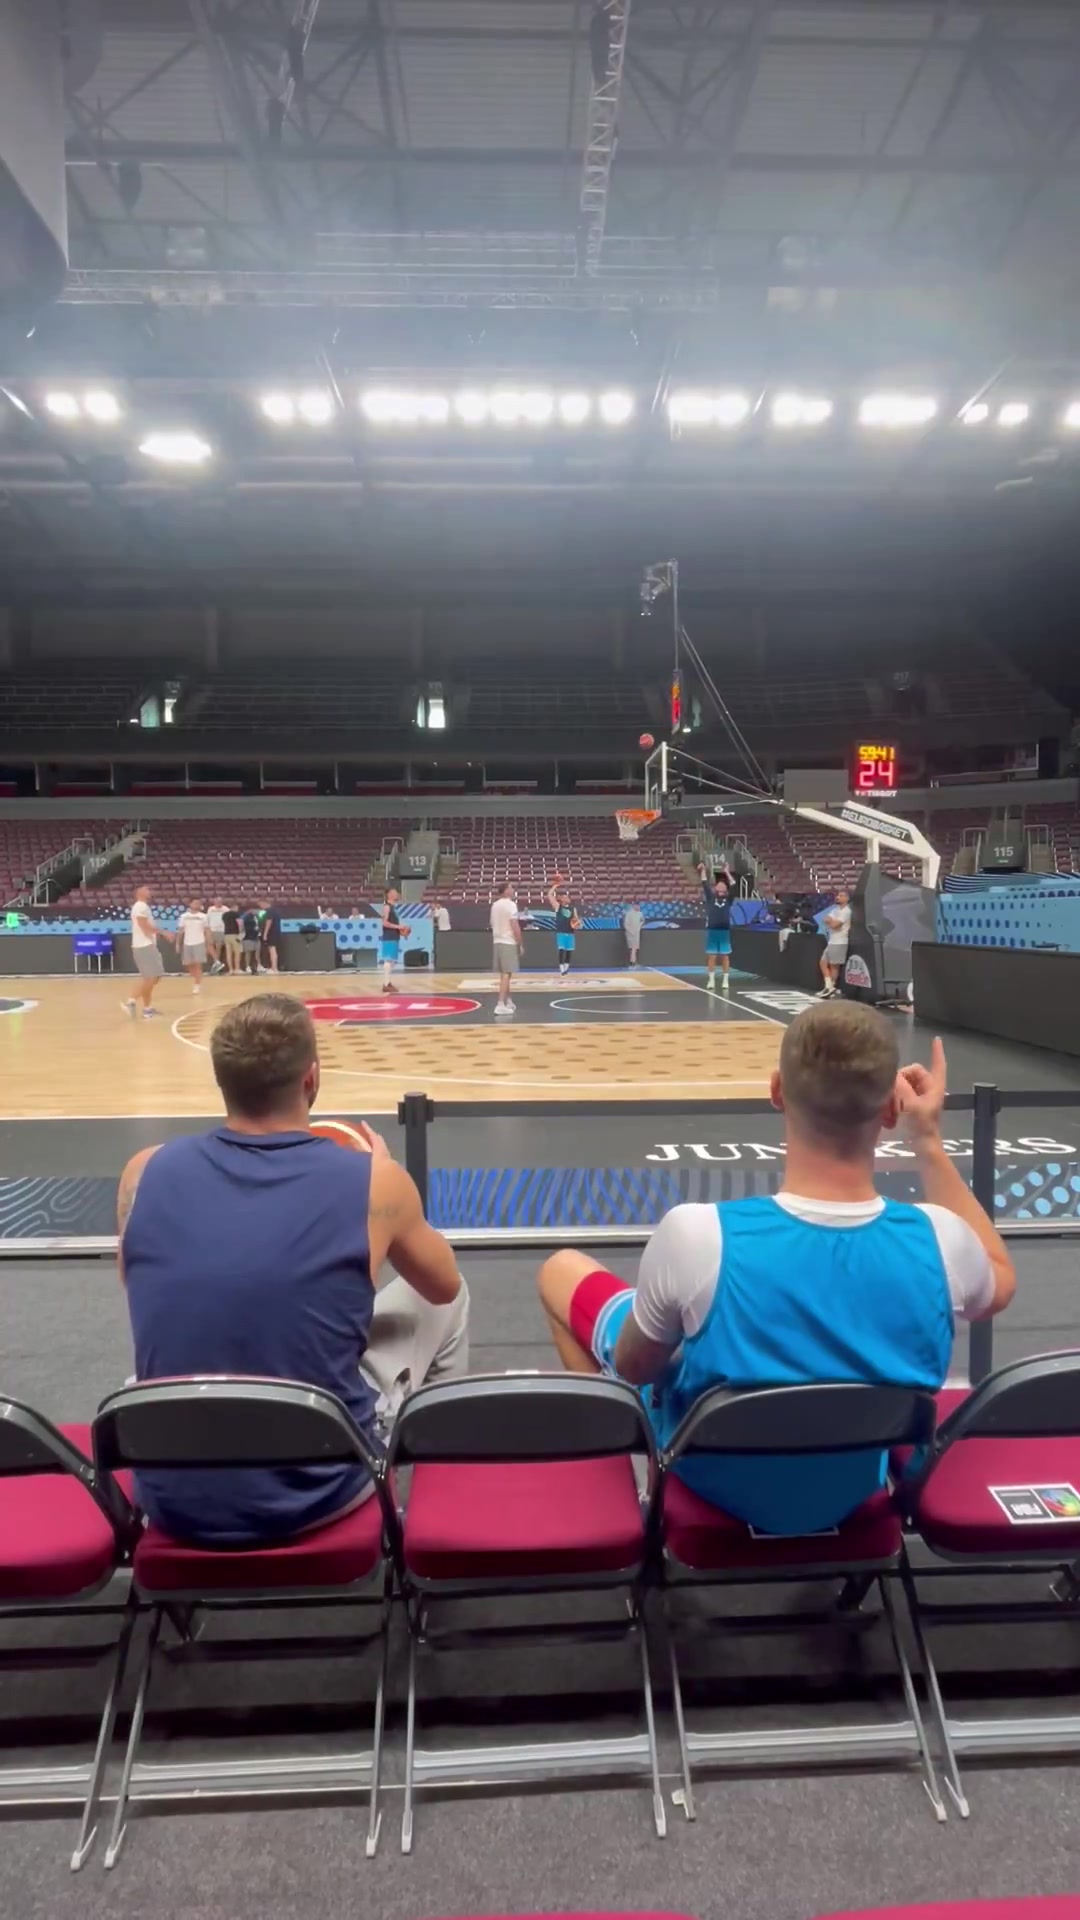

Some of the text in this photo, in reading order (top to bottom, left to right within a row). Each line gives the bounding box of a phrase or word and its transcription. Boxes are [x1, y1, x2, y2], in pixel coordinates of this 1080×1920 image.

[859, 760, 893, 787] 24
[994, 846, 1014, 857] 115
[409, 856, 427, 866] 113
